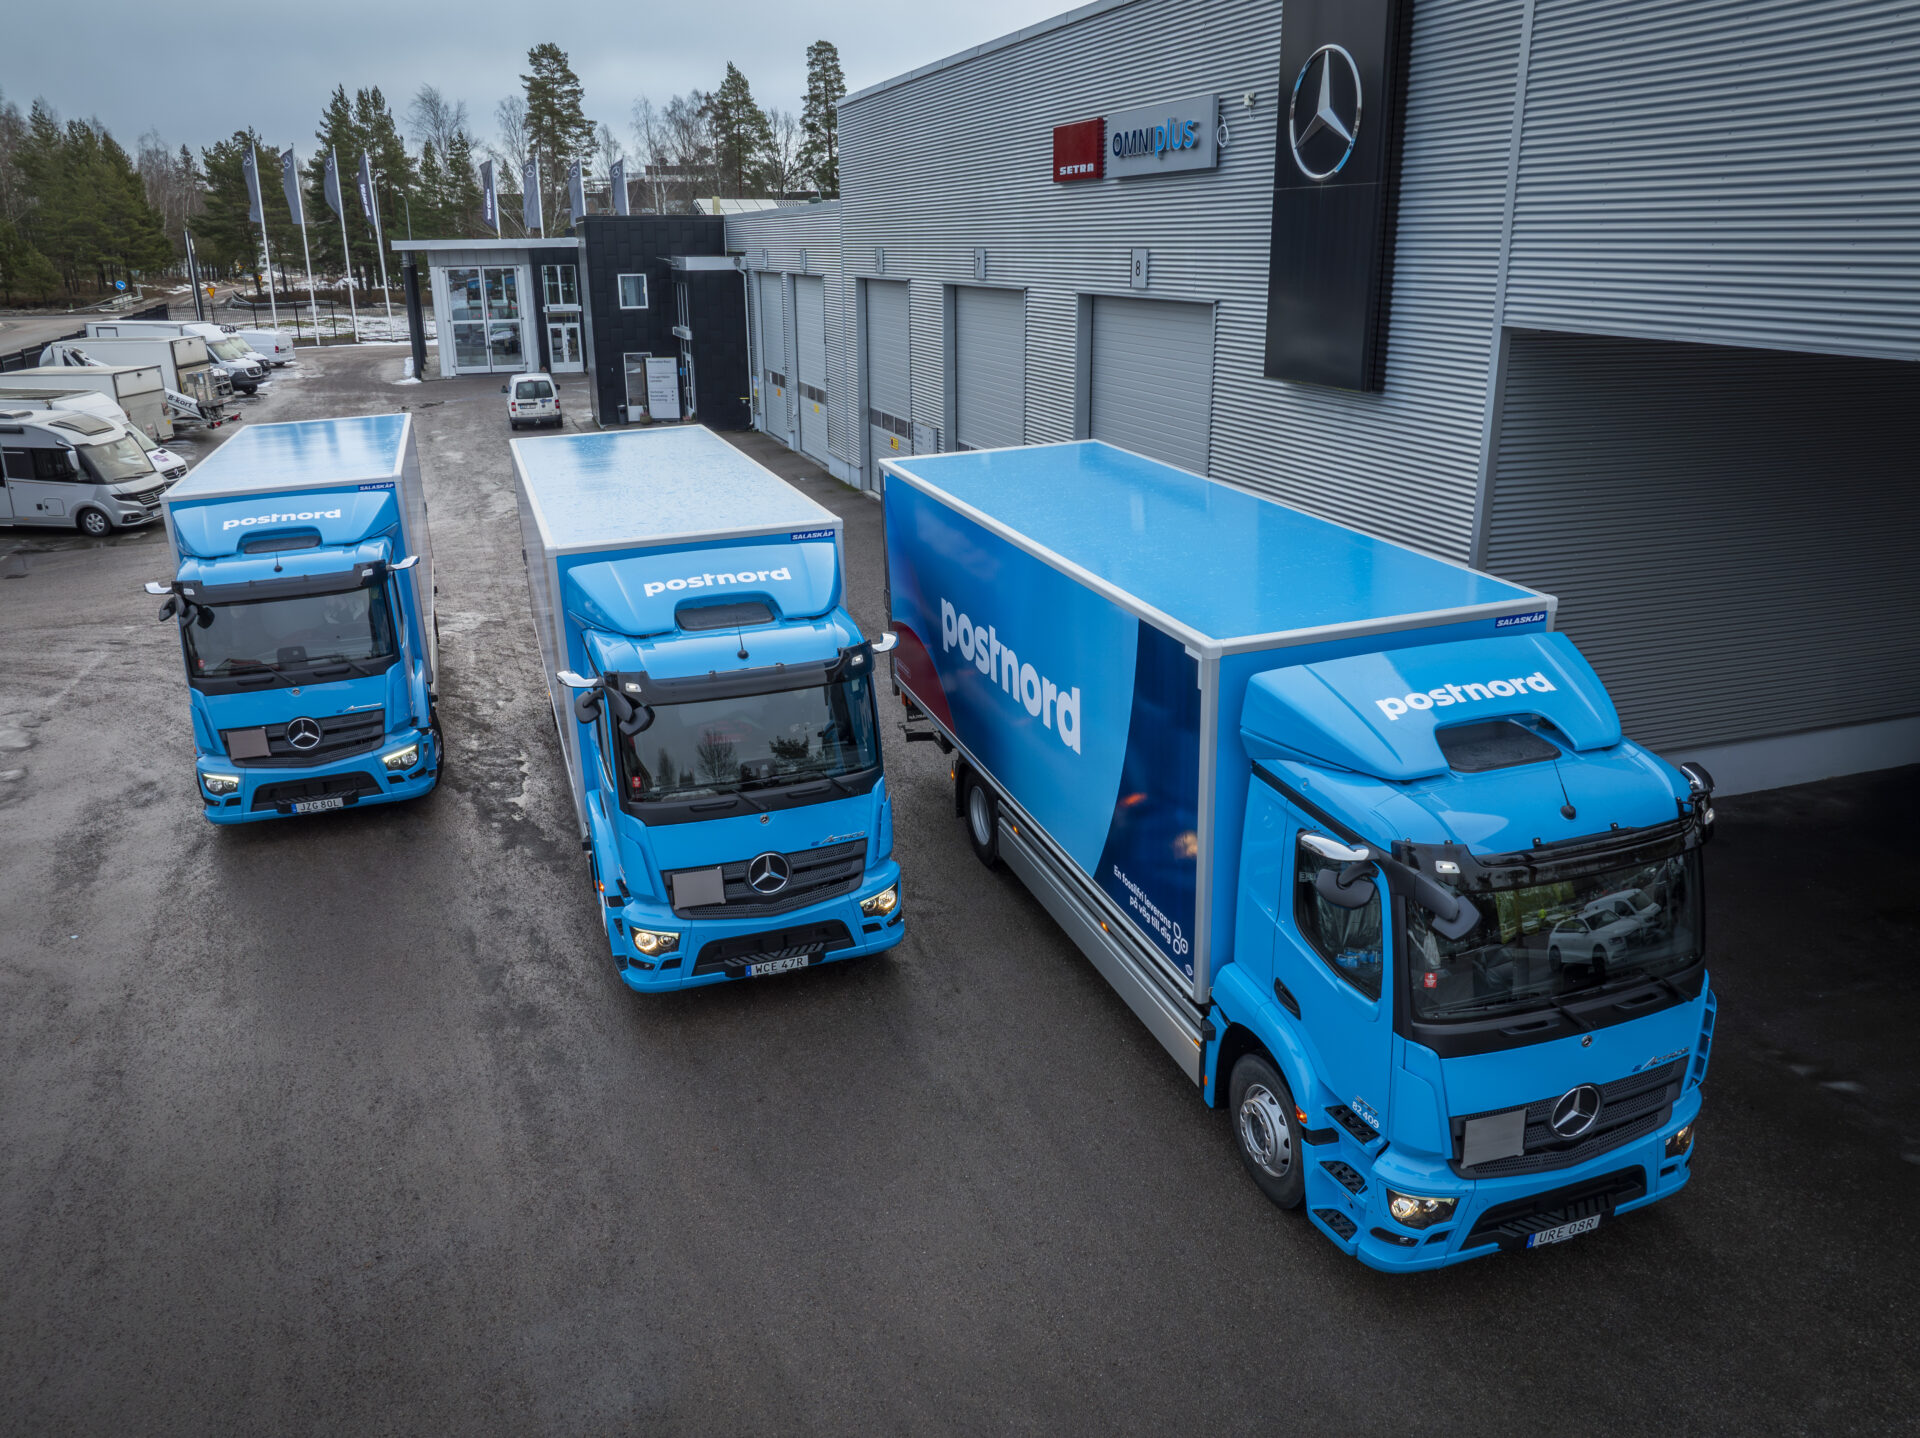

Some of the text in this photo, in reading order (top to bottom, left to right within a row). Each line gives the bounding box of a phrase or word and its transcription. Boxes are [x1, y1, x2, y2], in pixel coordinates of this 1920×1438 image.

[1112, 117, 1195, 158] OMNIplus
[1059, 162, 1095, 176] SETRA
[1135, 260, 1141, 277] 8
[167, 394, 193, 409] B-kort
[222, 508, 342, 531] postnord
[791, 529, 834, 541] SALASKÅP
[643, 567, 793, 598] postnord
[1496, 613, 1545, 628] SALASKÅP
[940, 596, 1081, 756] postnord
[1375, 671, 1559, 721] postnord
[300, 801, 319, 812] JZG
[1113, 864, 1171, 929] En fossilfri leverans
[1129, 895, 1171, 945] på väg till dig
[755, 957, 804, 974] WCE 47R
[1352, 1101, 1362, 1116] 82
[1362, 1112, 1380, 1129] 409
[1539, 1218, 1595, 1243] URE 08R
